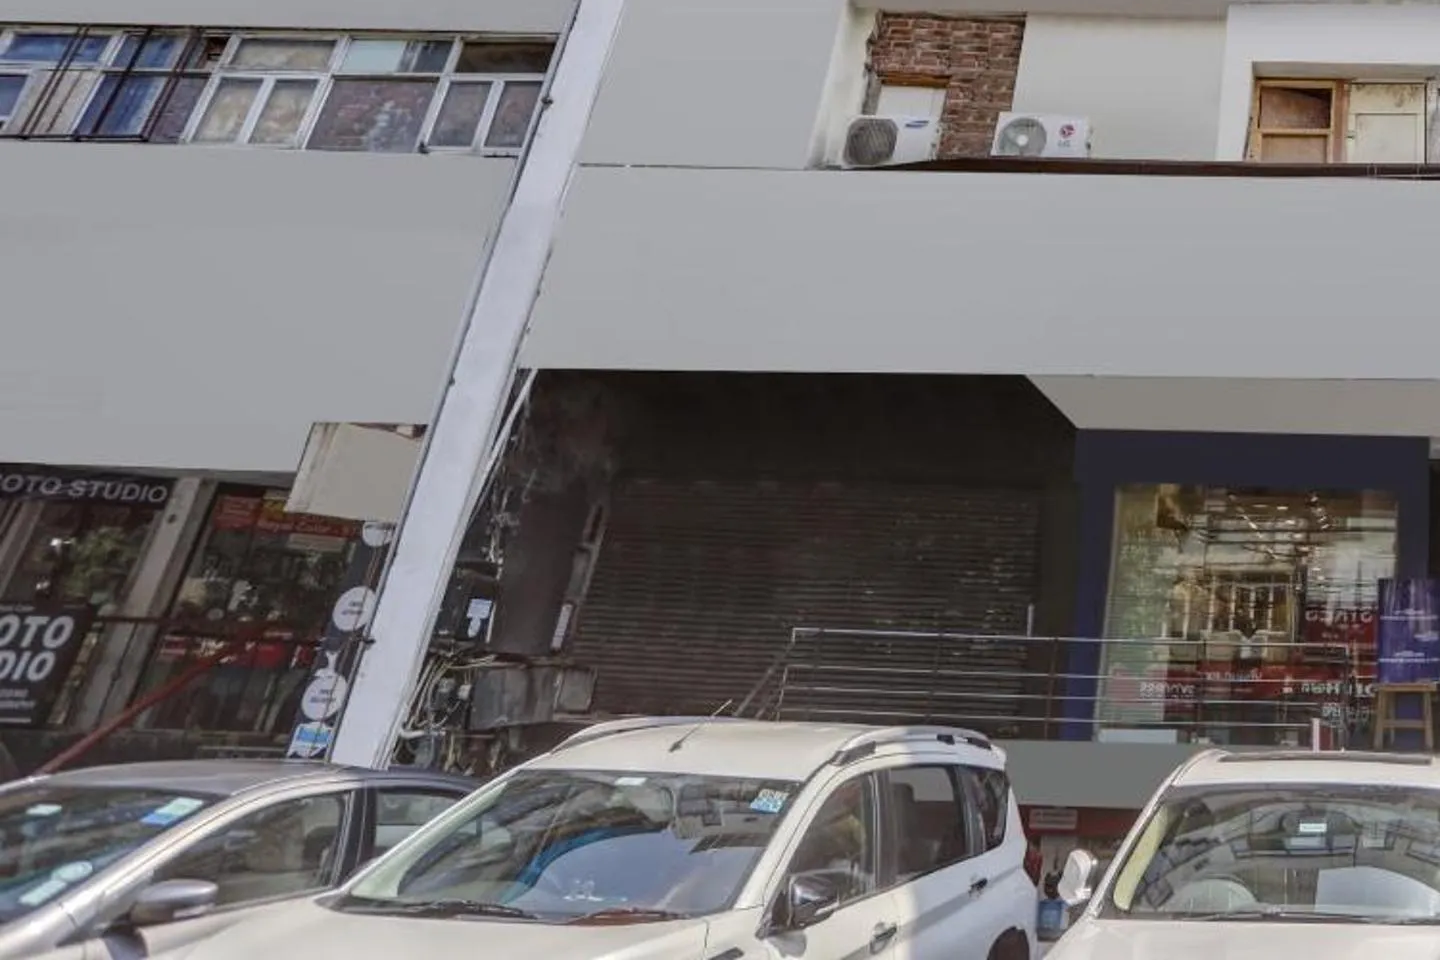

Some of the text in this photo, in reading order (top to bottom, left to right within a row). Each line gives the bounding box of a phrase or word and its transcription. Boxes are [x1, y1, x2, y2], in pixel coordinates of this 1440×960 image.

[0, 473, 168, 502] OTO STUDIO
[0, 614, 74, 649] OTO
